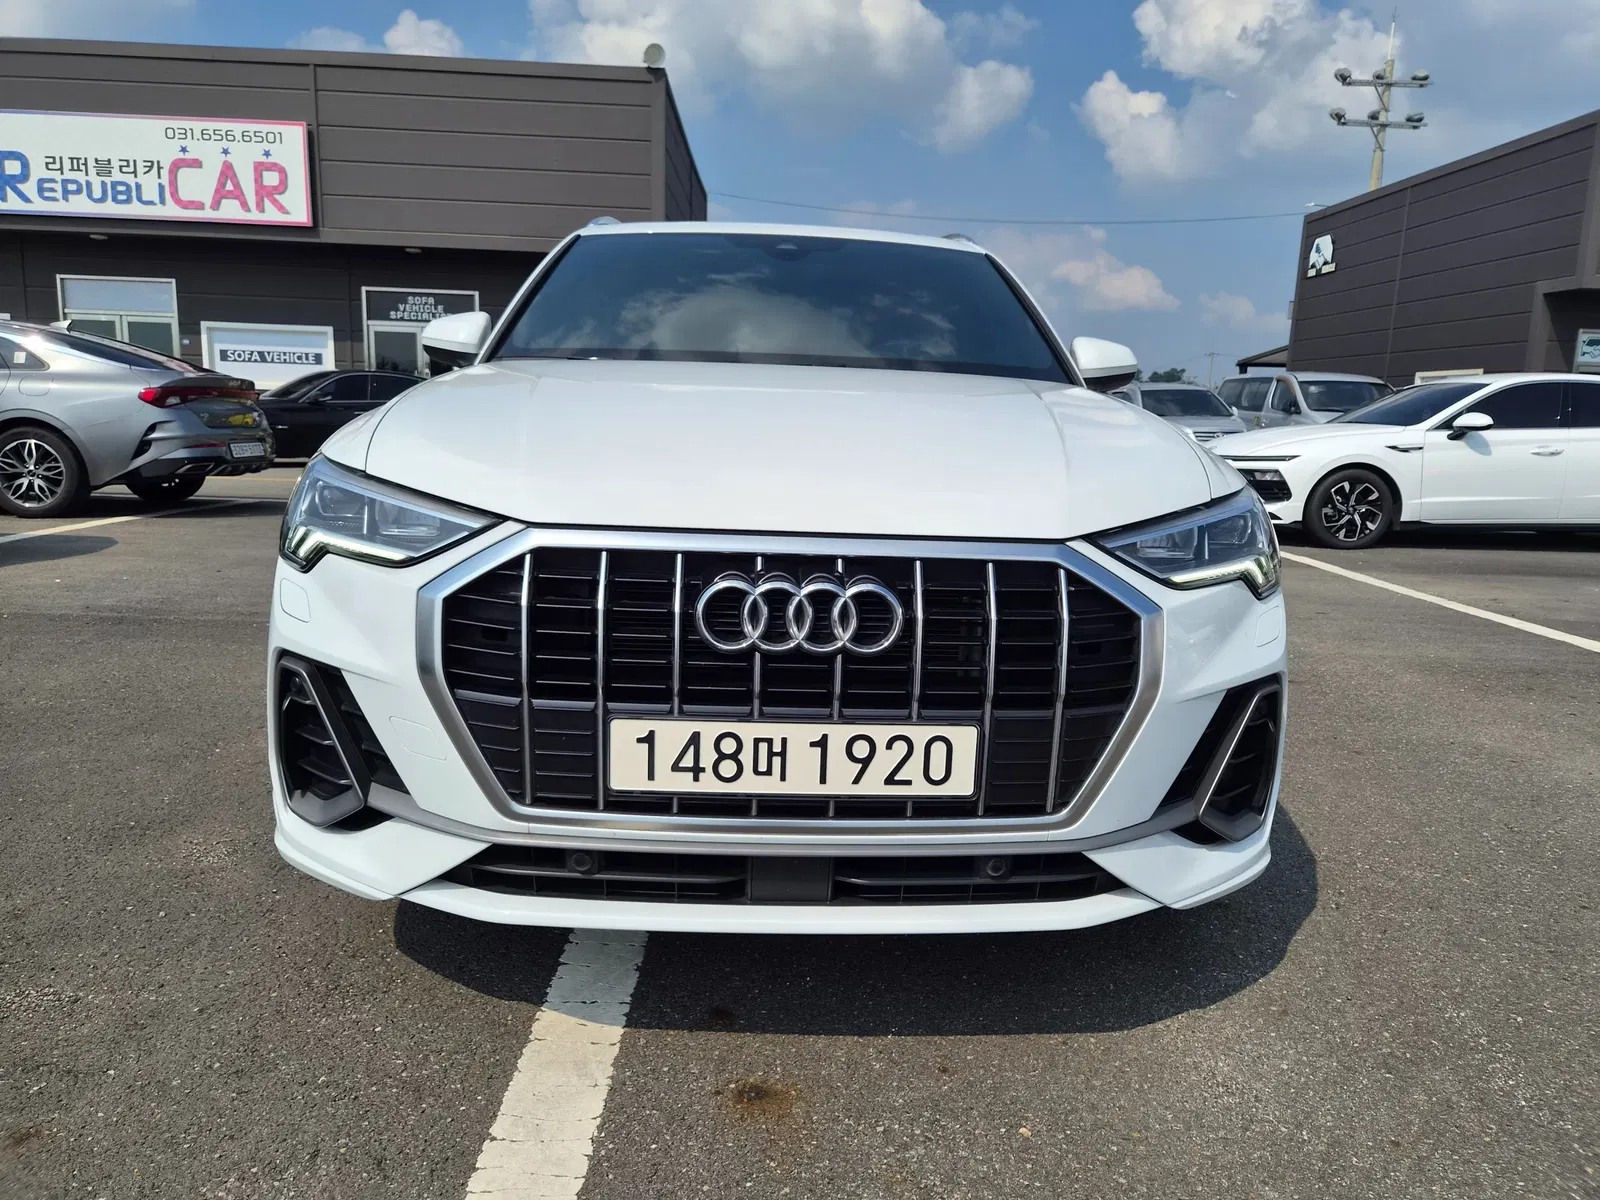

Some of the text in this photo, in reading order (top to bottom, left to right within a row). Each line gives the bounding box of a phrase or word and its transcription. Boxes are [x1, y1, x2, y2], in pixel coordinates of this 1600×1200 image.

[164, 126, 284, 145] 031.656.6501
[44, 155, 165, 179] 리퍼블리카
[398, 304, 444, 313] VEHICLE
[407, 296, 435, 305] SOFA
[227, 350, 316, 363] SOFA VEHICLE
[636, 729, 954, 786] 148머 1920
